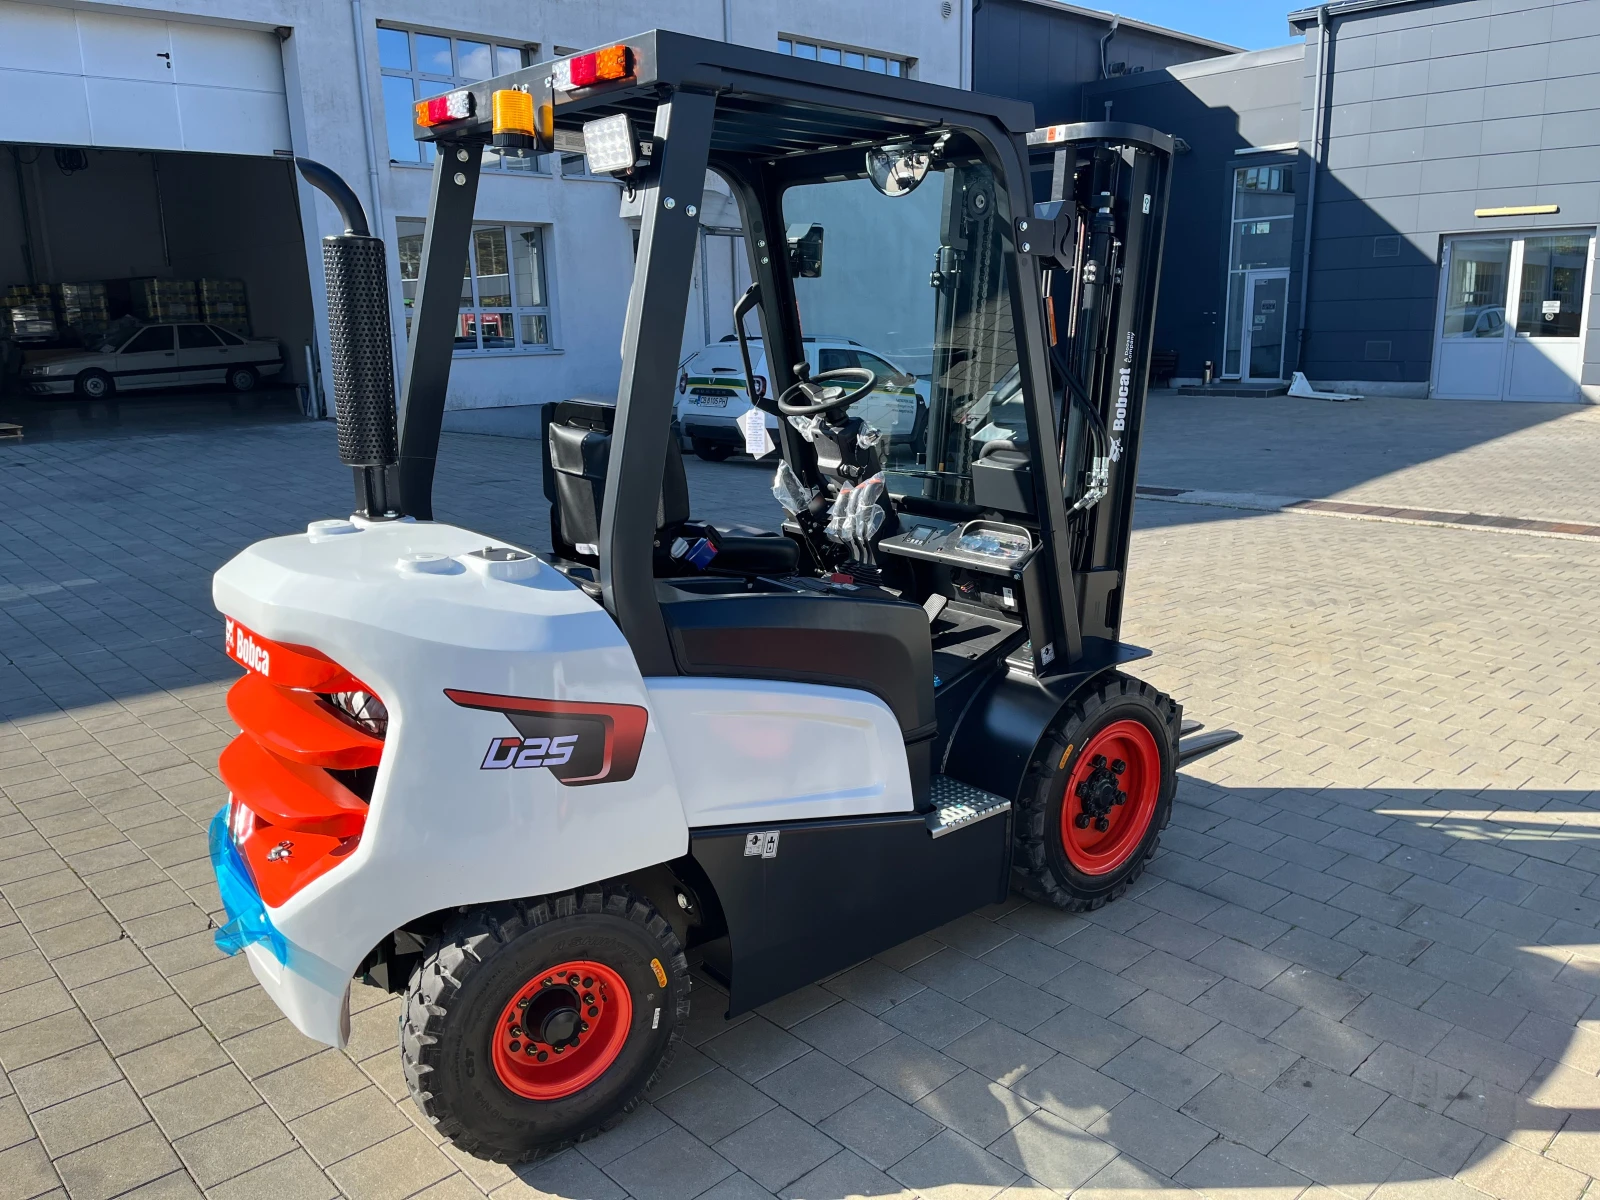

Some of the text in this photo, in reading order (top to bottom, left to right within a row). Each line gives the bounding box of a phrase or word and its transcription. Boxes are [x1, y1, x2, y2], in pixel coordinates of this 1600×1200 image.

[1127, 332, 1136, 363] Company
[1113, 367, 1131, 431] Bobcat
[236, 628, 270, 677] Bobca
[480, 734, 578, 770] D25
[464, 1046, 476, 1080] CST
